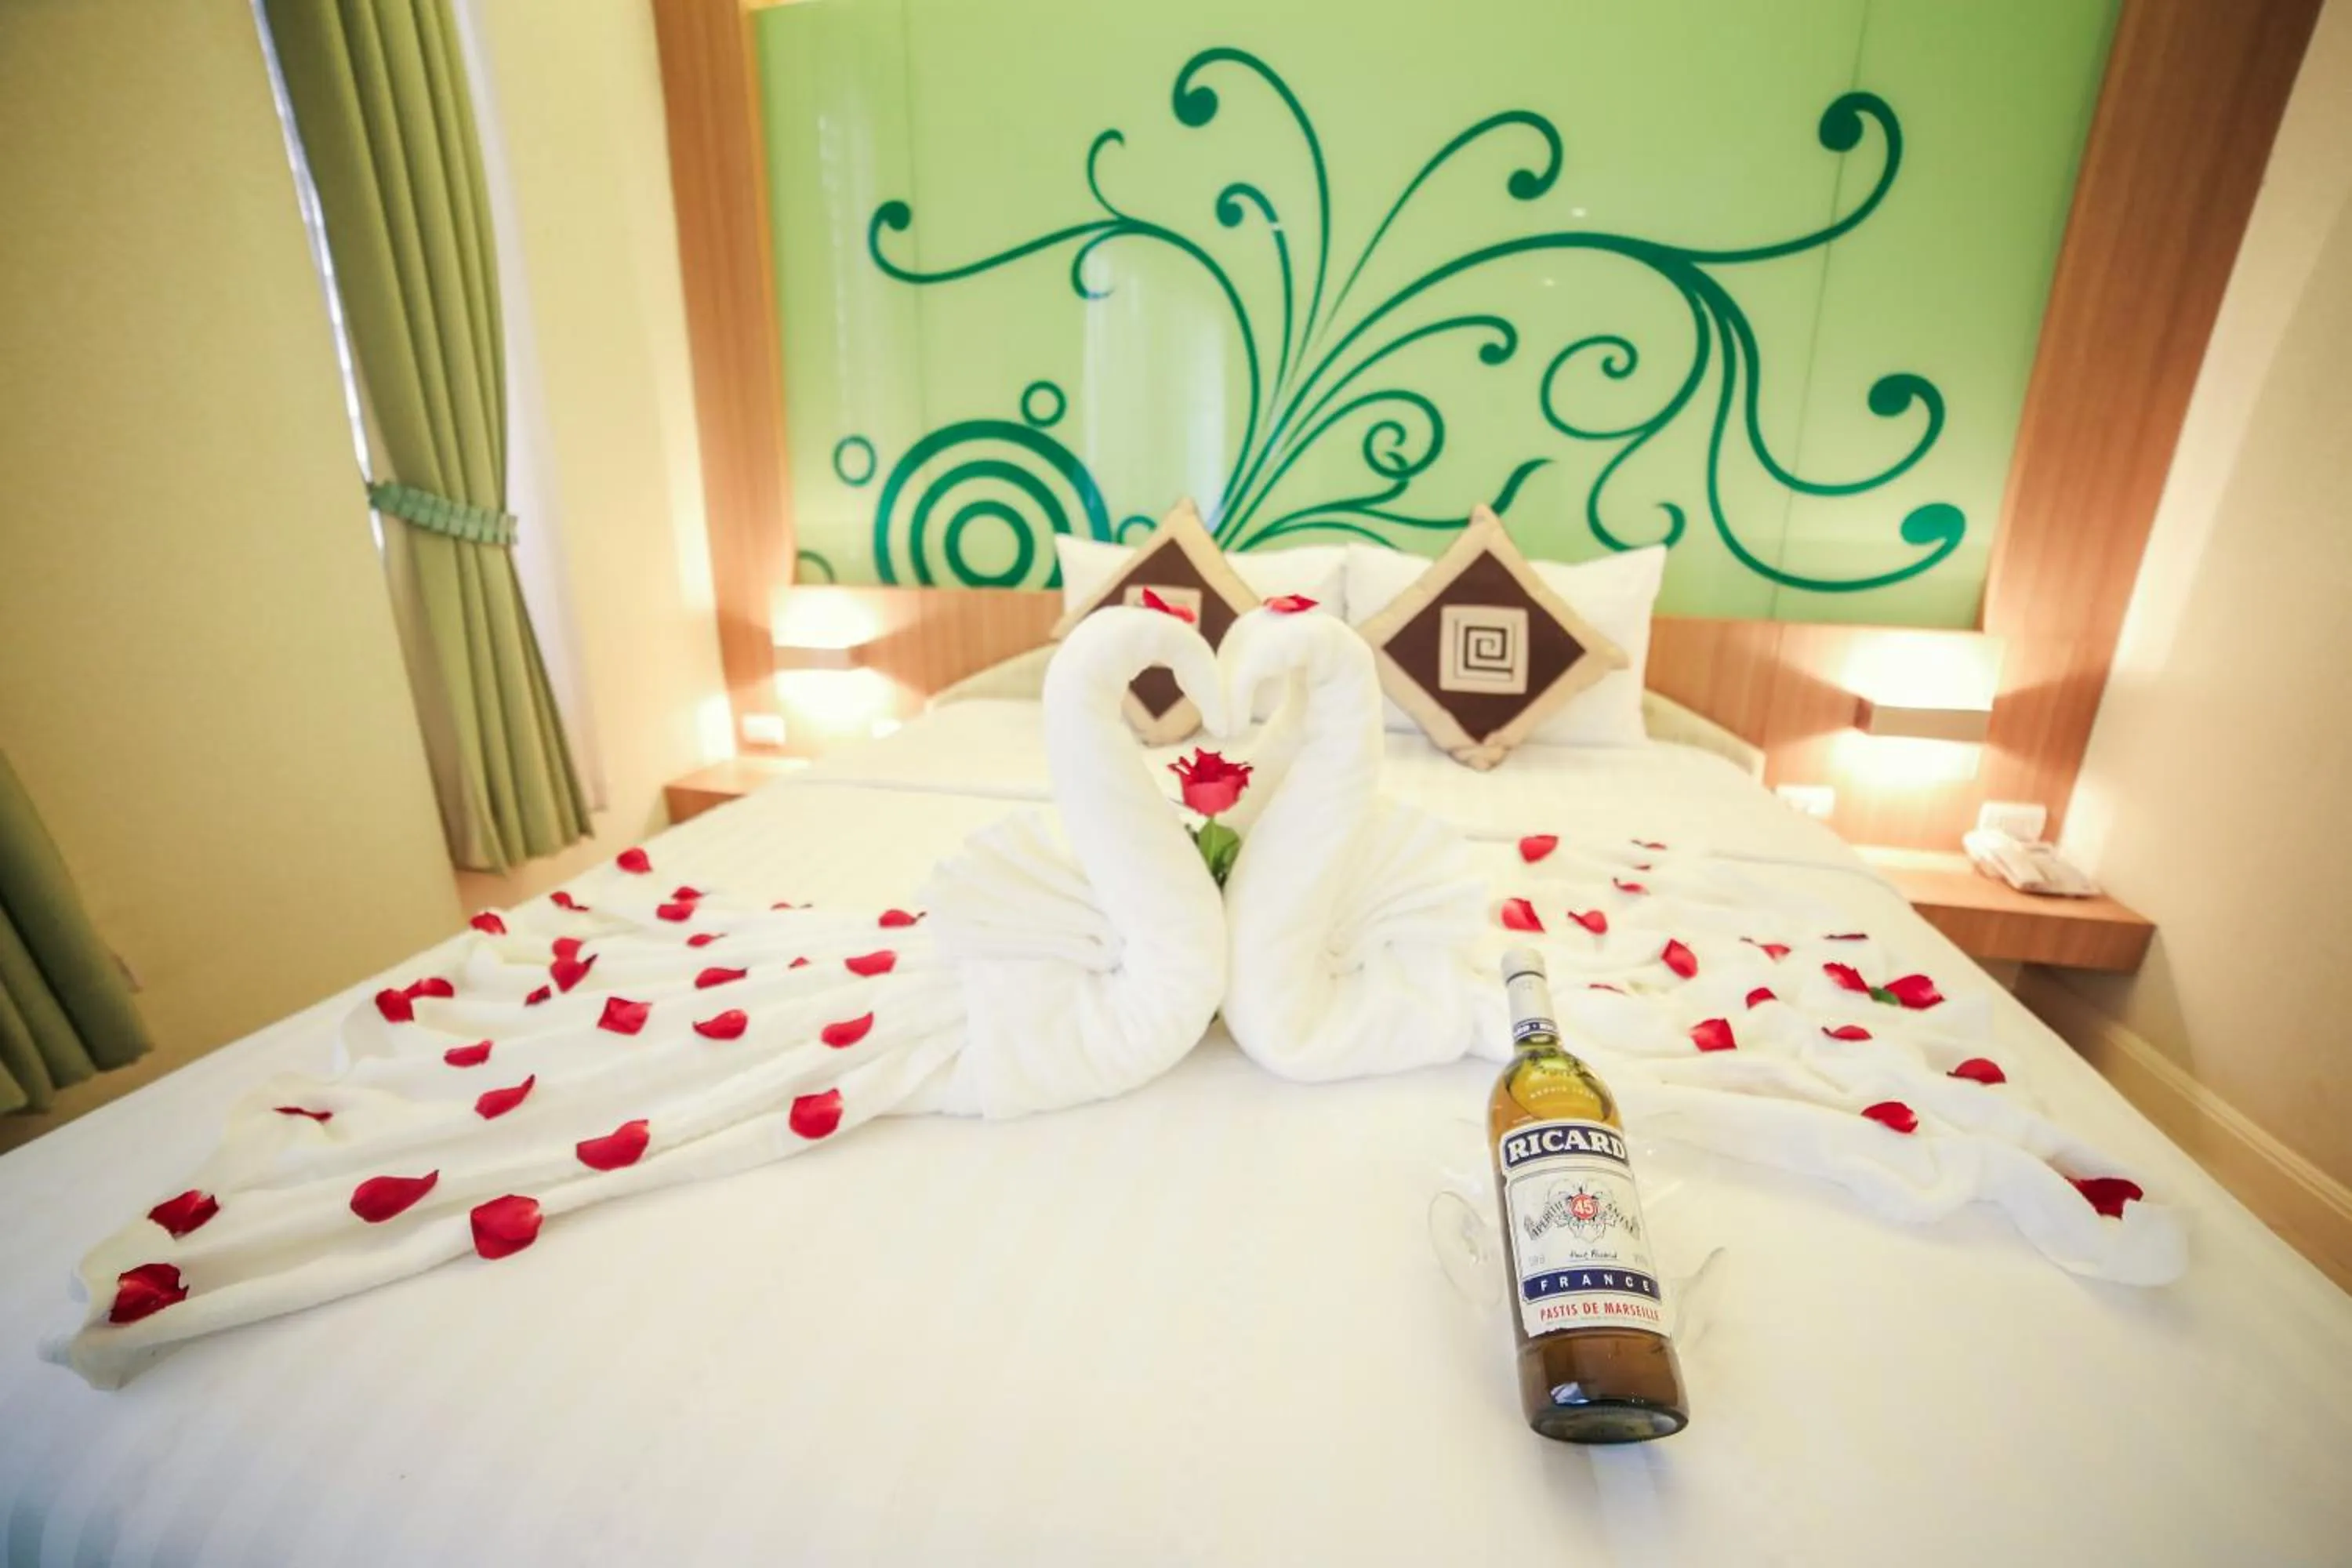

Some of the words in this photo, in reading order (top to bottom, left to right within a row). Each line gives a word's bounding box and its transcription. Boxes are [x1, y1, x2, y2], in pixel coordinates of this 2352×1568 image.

[1507, 1129, 1626, 1163] RICARD
[1573, 1199, 1595, 1214] 45
[1540, 1274, 1650, 1292] FRANCE
[1540, 1304, 1578, 1322] PASTIS
[1582, 1301, 1599, 1315] DE
[1604, 1302, 1661, 1322] MARSEILLE
